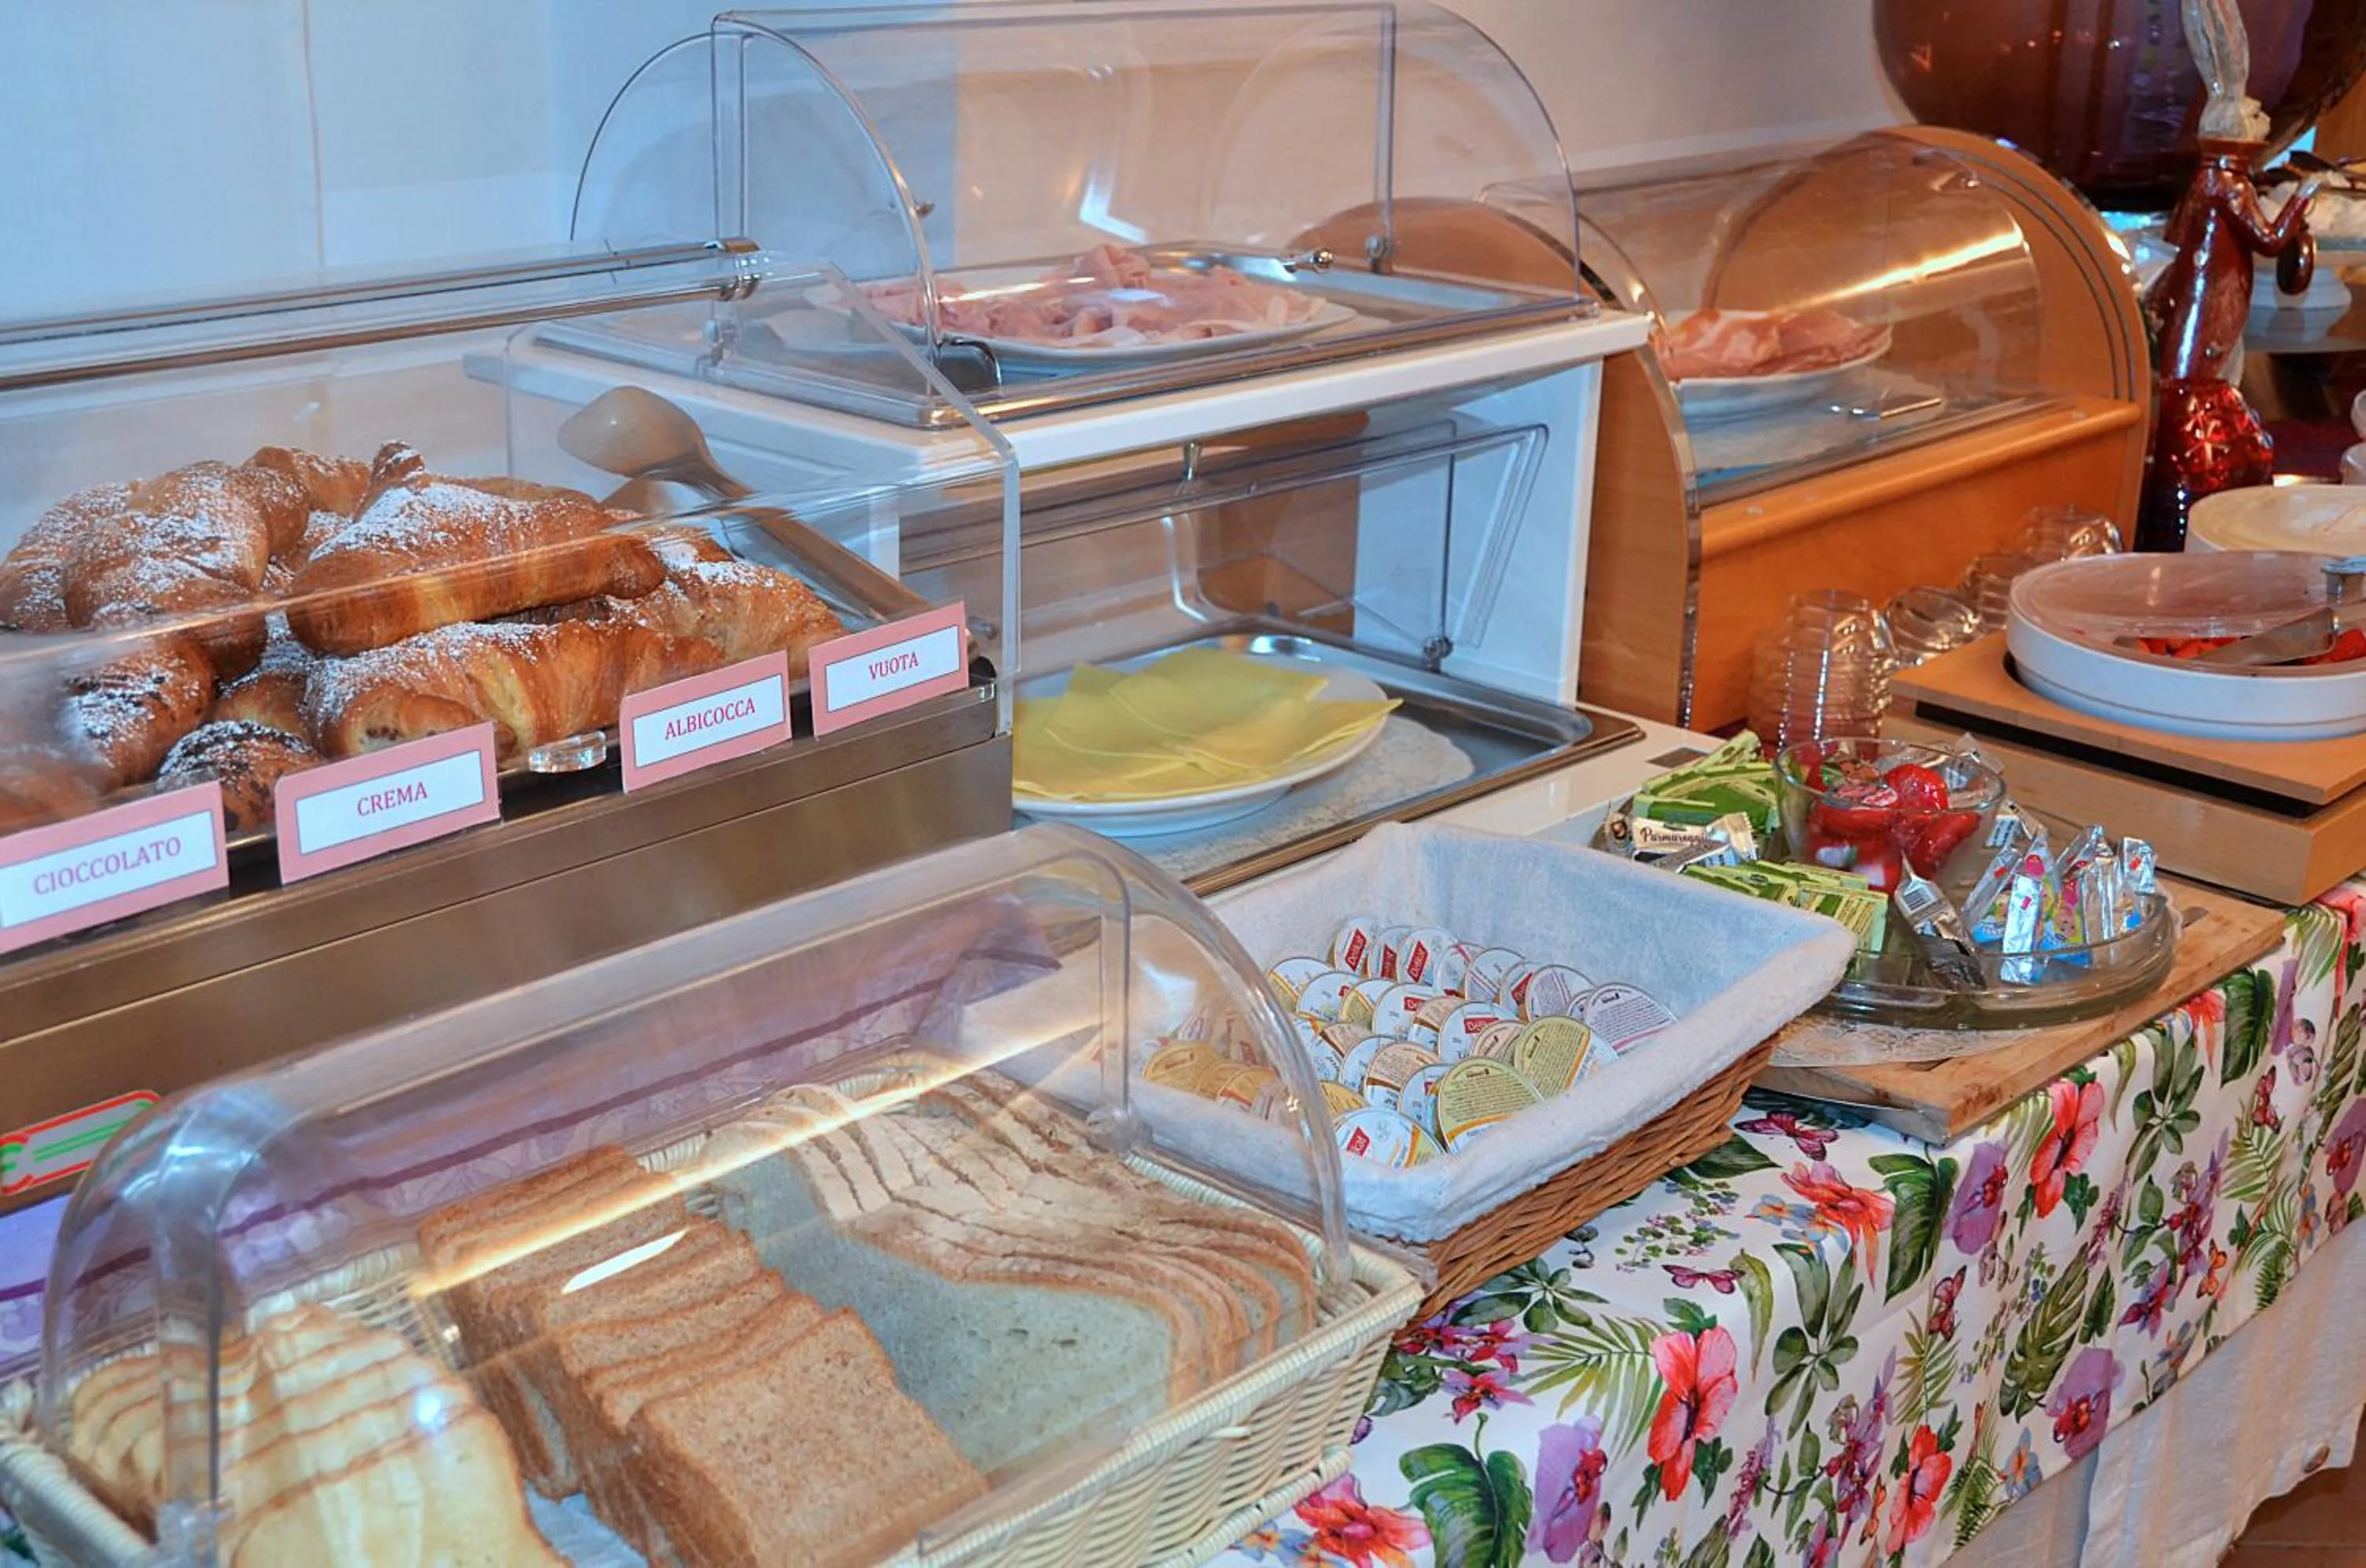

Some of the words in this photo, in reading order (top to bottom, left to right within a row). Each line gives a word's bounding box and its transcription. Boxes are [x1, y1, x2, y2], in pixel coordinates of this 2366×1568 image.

[868, 651, 919, 681] VUOTA
[665, 697, 756, 740] ALBICOCCA
[357, 781, 428, 817] CREMA
[34, 836, 181, 895] CIOCCOLATO
